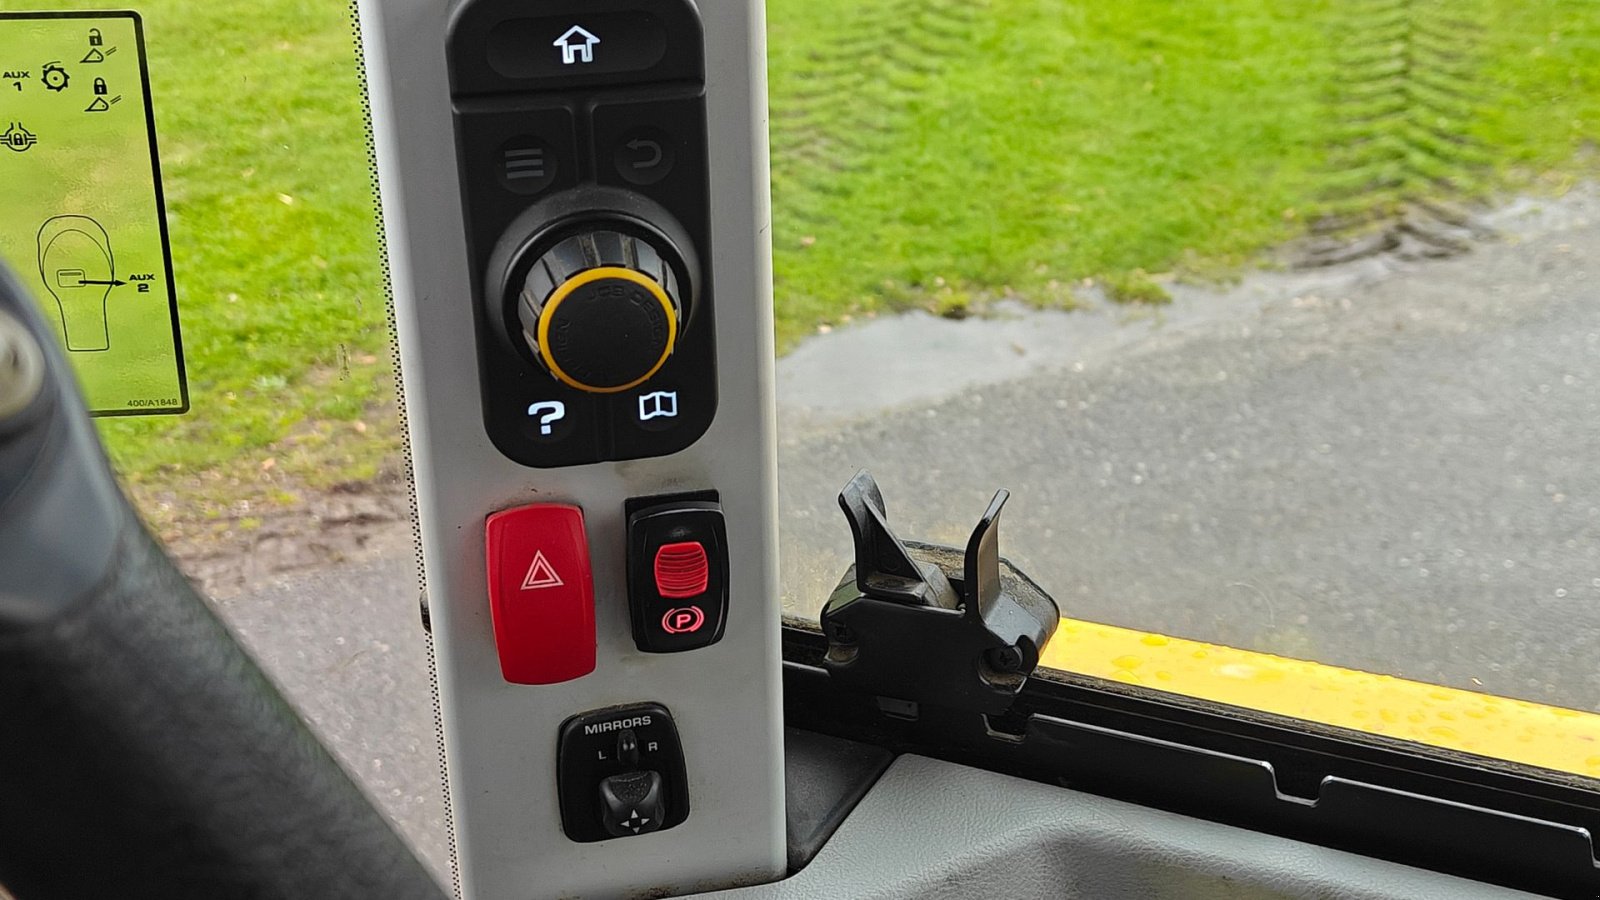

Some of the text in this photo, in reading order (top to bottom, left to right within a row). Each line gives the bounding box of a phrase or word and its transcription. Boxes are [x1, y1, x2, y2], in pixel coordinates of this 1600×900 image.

[2, 71, 31, 79] AUX
[13, 81, 22, 92] 1
[129, 273, 156, 281] AUX
[137, 283, 150, 293] 2
[127, 398, 178, 408] 400/A1848
[676, 614, 692, 629] P
[584, 715, 652, 736] MIRRORS
[598, 741, 658, 760] L R
